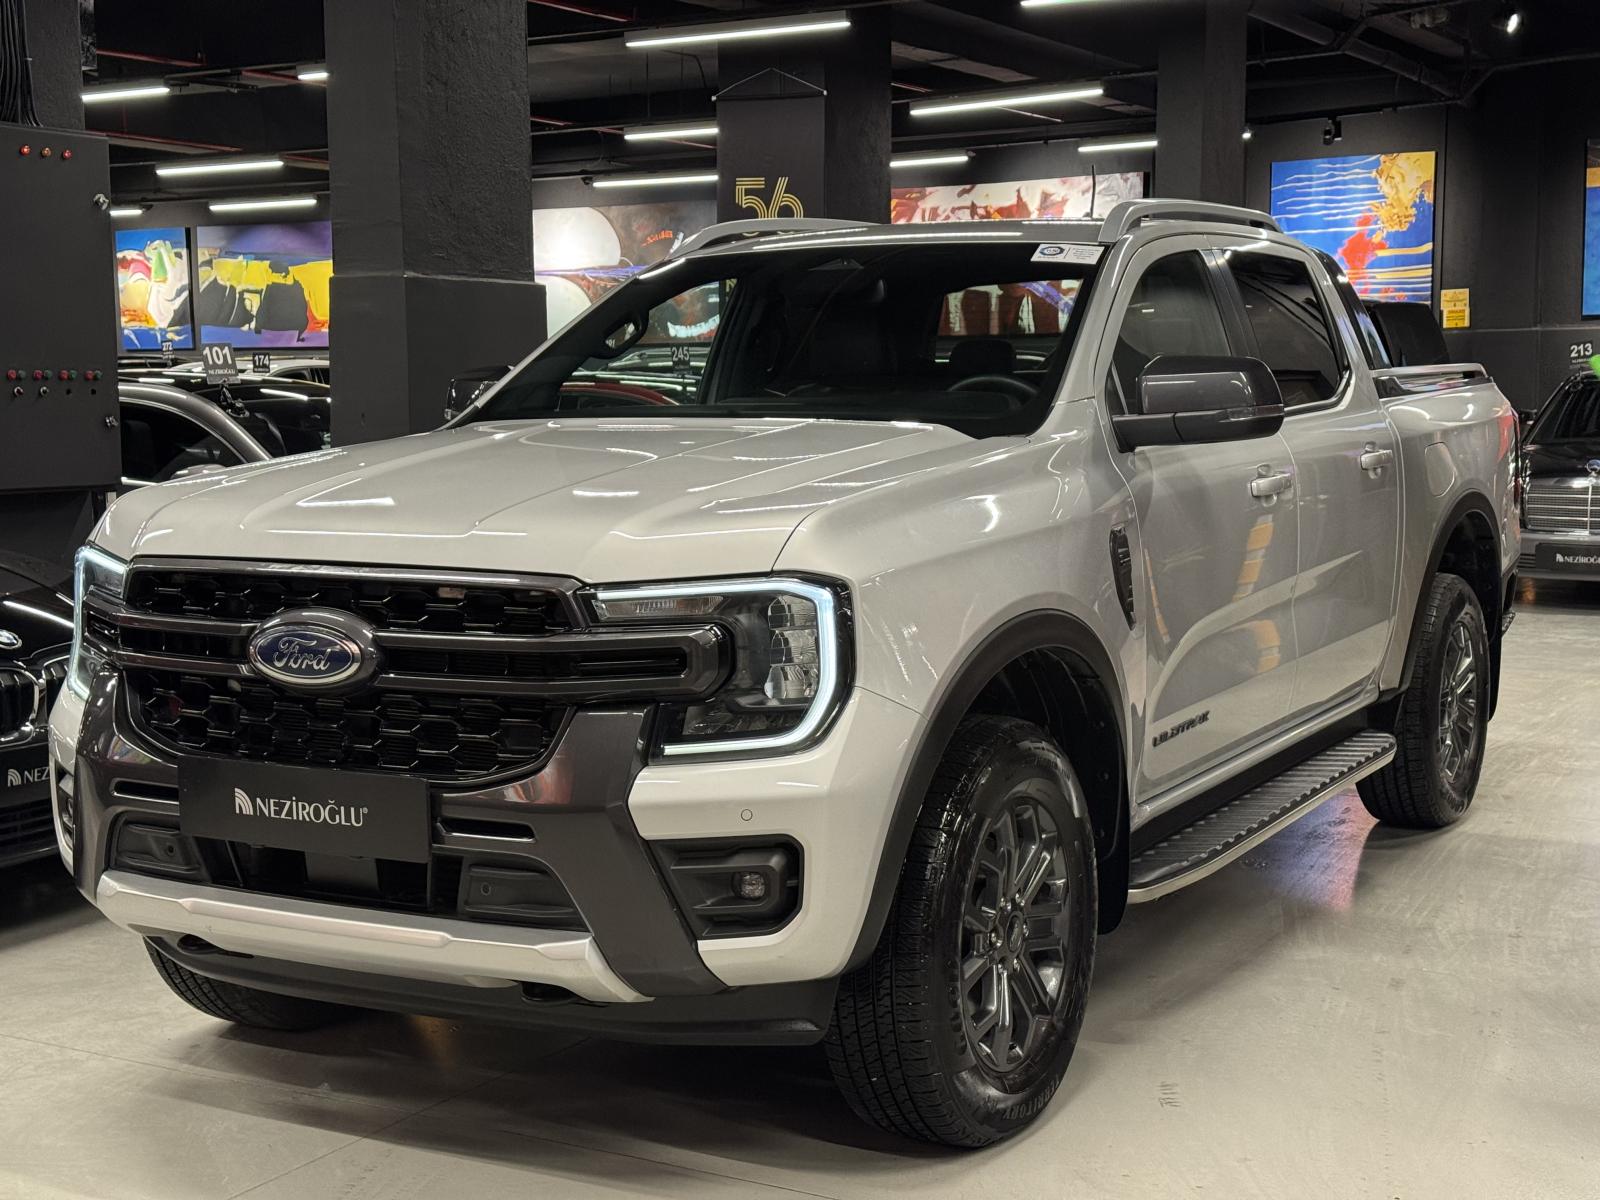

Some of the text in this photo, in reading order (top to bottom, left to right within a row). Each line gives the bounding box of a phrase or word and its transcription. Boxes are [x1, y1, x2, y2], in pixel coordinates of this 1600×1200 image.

[735, 177, 804, 236] 56
[203, 346, 232, 365] 101
[672, 347, 689, 361] 245
[1570, 343, 1593, 357] 213
[254, 354, 270, 366] 174
[273, 636, 331, 671] Ford
[256, 796, 363, 827] NEZİROĞLU
